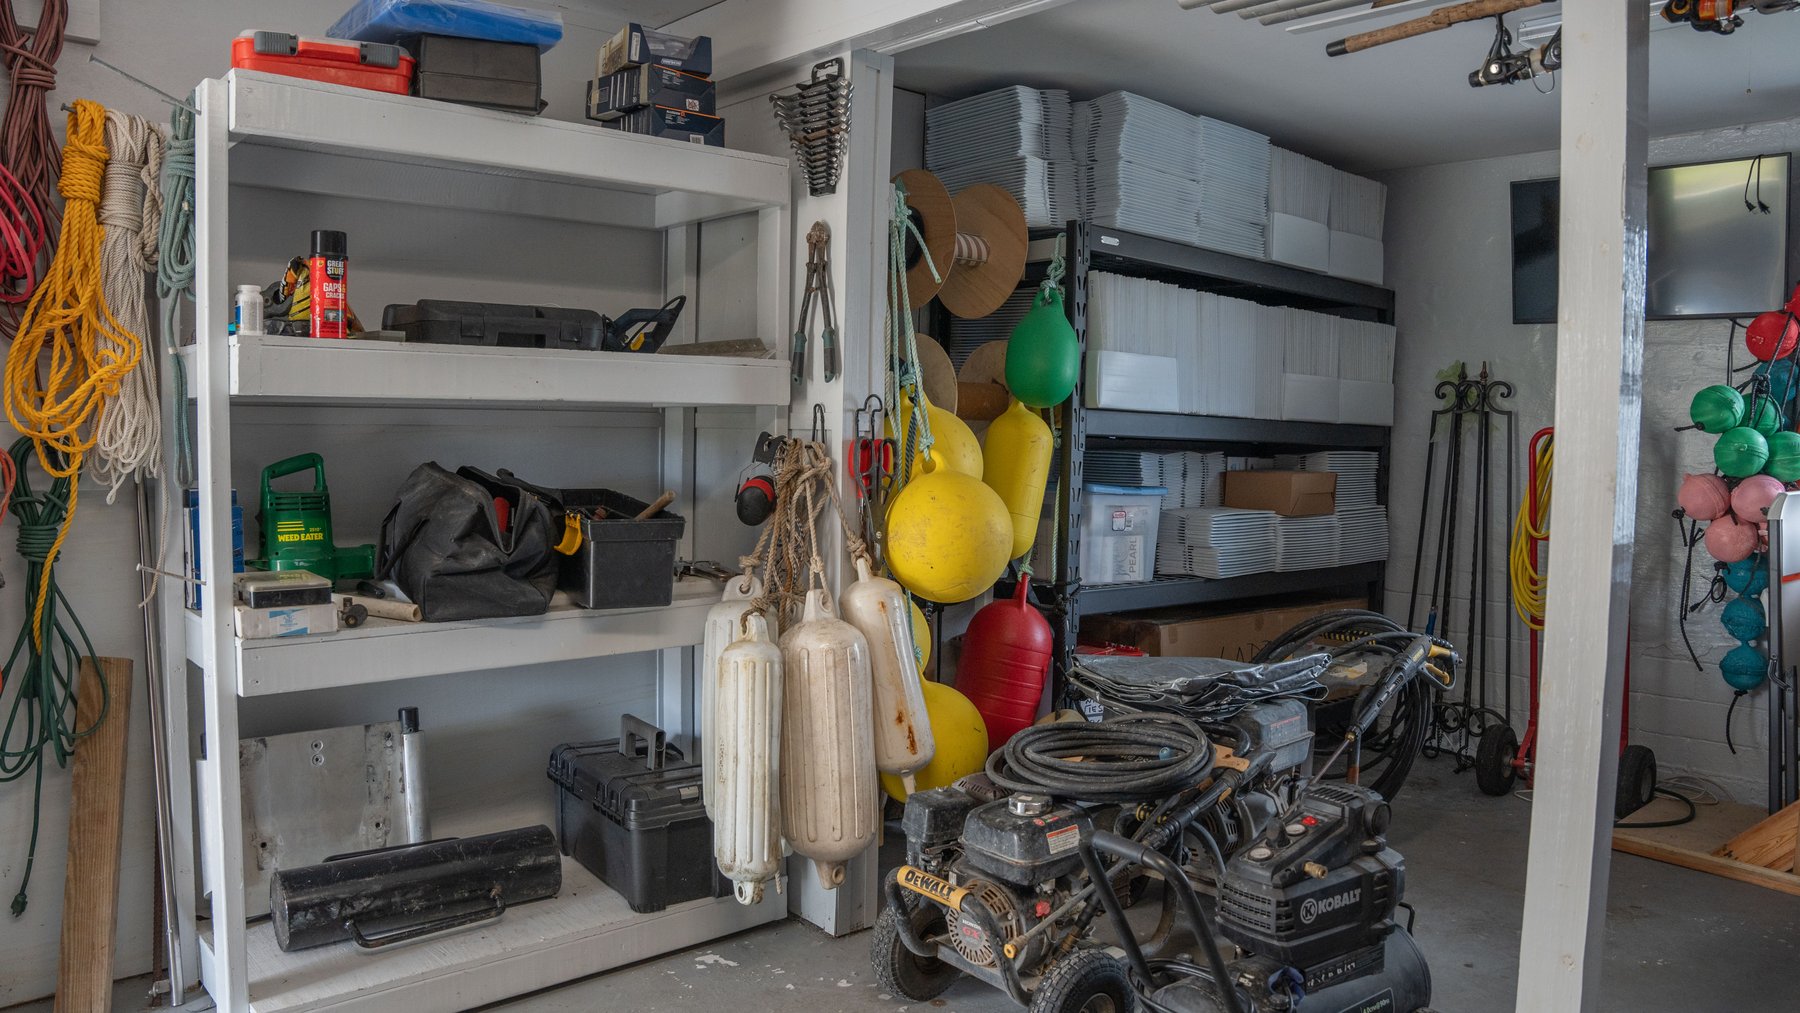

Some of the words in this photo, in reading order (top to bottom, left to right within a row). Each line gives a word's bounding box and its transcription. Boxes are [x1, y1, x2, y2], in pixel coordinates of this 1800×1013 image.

[327, 267, 344, 275] STUFF
[323, 283, 341, 292] GAPS
[278, 533, 300, 542] WEED
[300, 533, 323, 541] EATER
[1128, 537, 1137, 573] PEARL
[904, 870, 955, 900] DEWALT
[1318, 888, 1361, 915] KOBALT
[962, 927, 979, 939] GX
